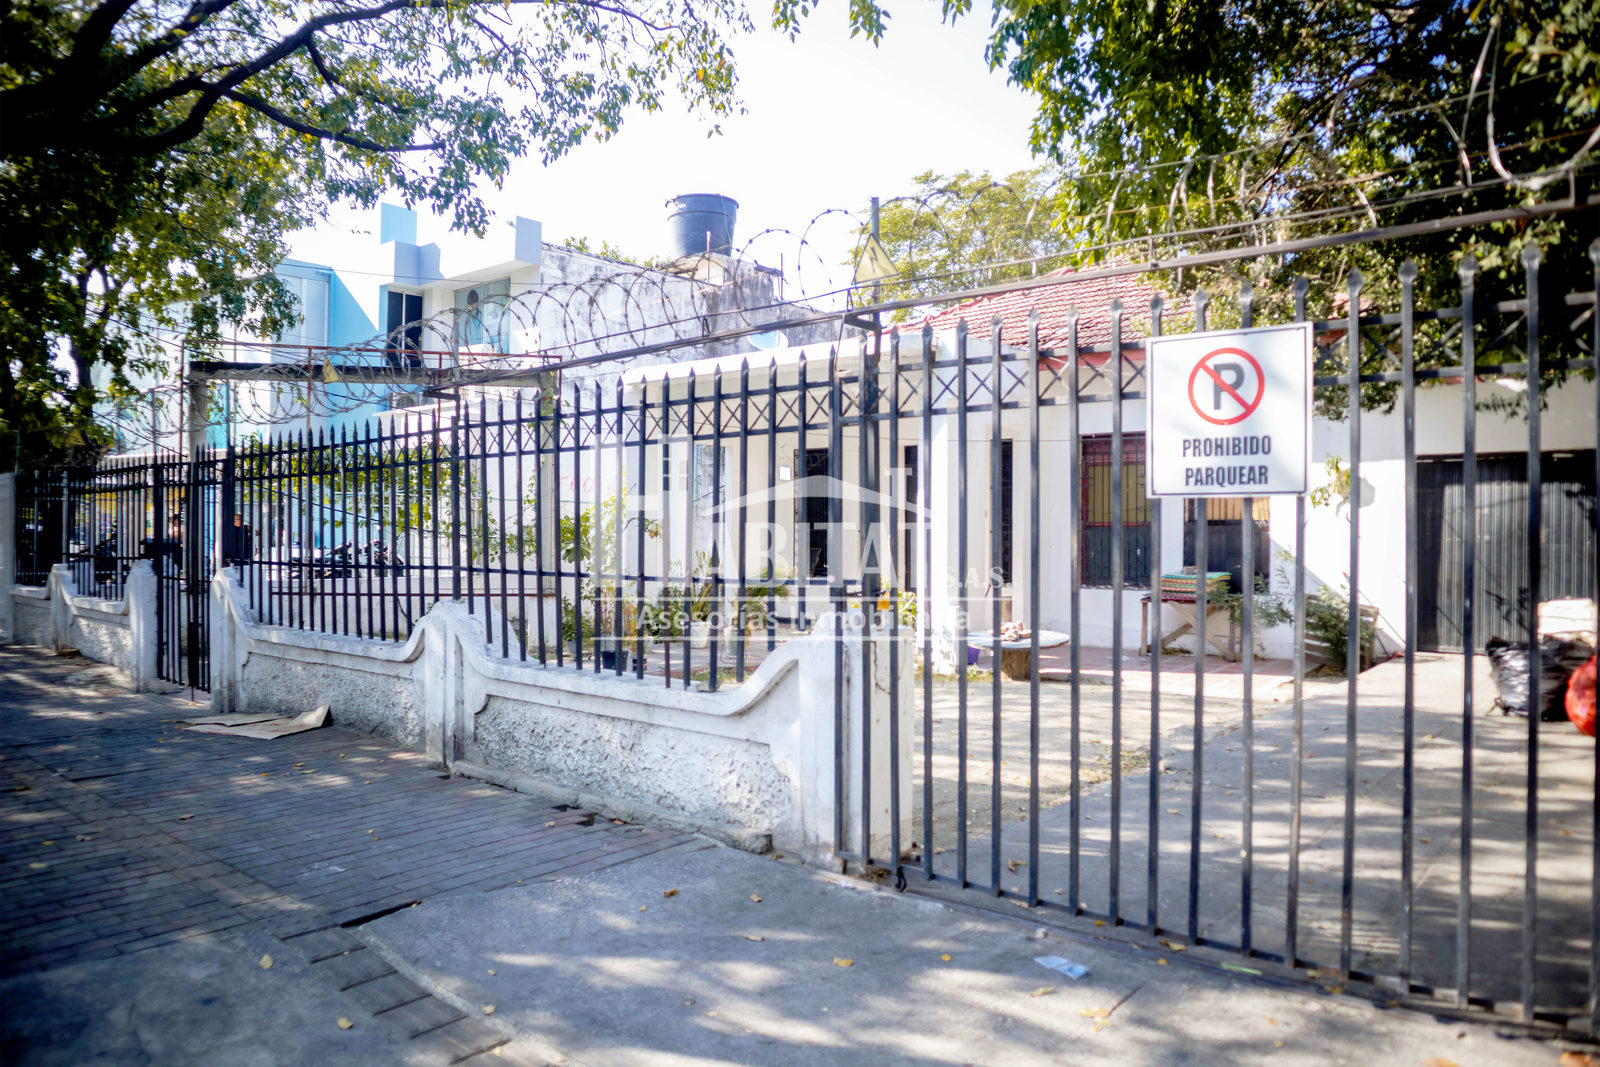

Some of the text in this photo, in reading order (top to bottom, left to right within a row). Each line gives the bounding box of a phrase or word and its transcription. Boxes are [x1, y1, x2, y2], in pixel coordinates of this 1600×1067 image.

[1213, 362, 1245, 410] P
[1182, 435, 1272, 458] PROHIBIDO
[1185, 465, 1269, 488] PARQUEAR
